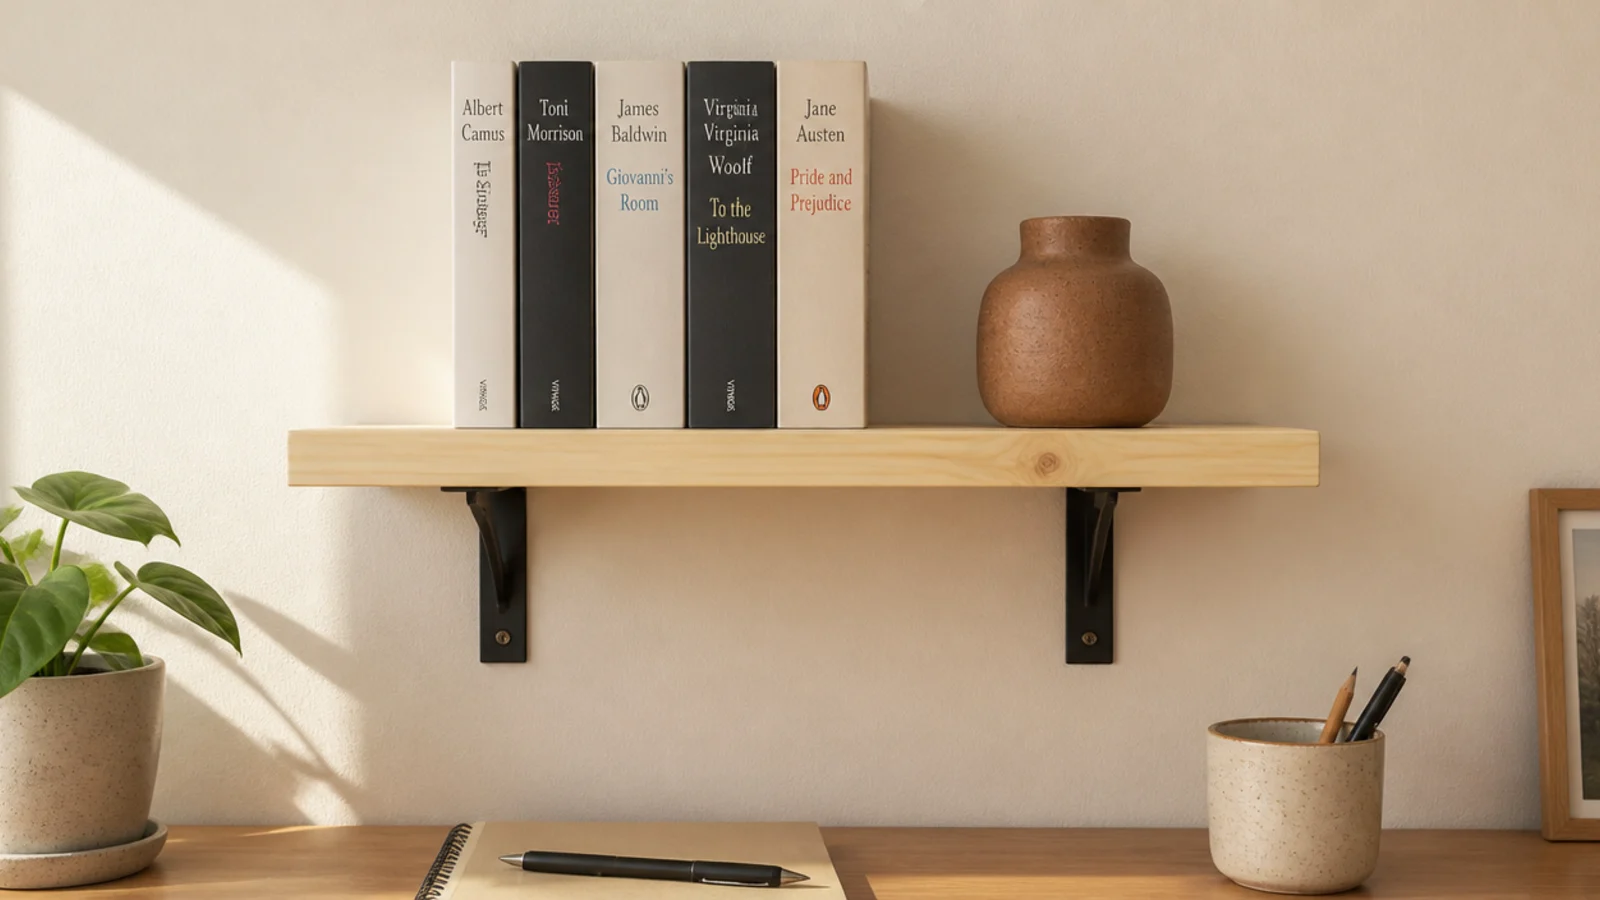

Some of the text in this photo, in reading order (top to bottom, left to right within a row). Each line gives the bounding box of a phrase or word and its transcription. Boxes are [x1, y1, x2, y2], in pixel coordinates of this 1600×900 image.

[463, 98, 503, 115] Albert
[539, 98, 568, 116] Toni
[617, 98, 658, 118] James
[804, 98, 837, 119] Jane
[461, 123, 505, 142] Camus
[527, 124, 583, 142] Morrison
[611, 125, 667, 142] Baldwin
[703, 123, 759, 147] Virginia
[796, 125, 845, 142] Austen
[708, 155, 753, 175] Woolf
[606, 168, 674, 185] Giovanni's
[790, 168, 853, 185] Pride and
[620, 194, 659, 212] Room
[709, 197, 752, 218] To the
[790, 194, 852, 215] Prejudice
[697, 226, 766, 250] Lighthouse
